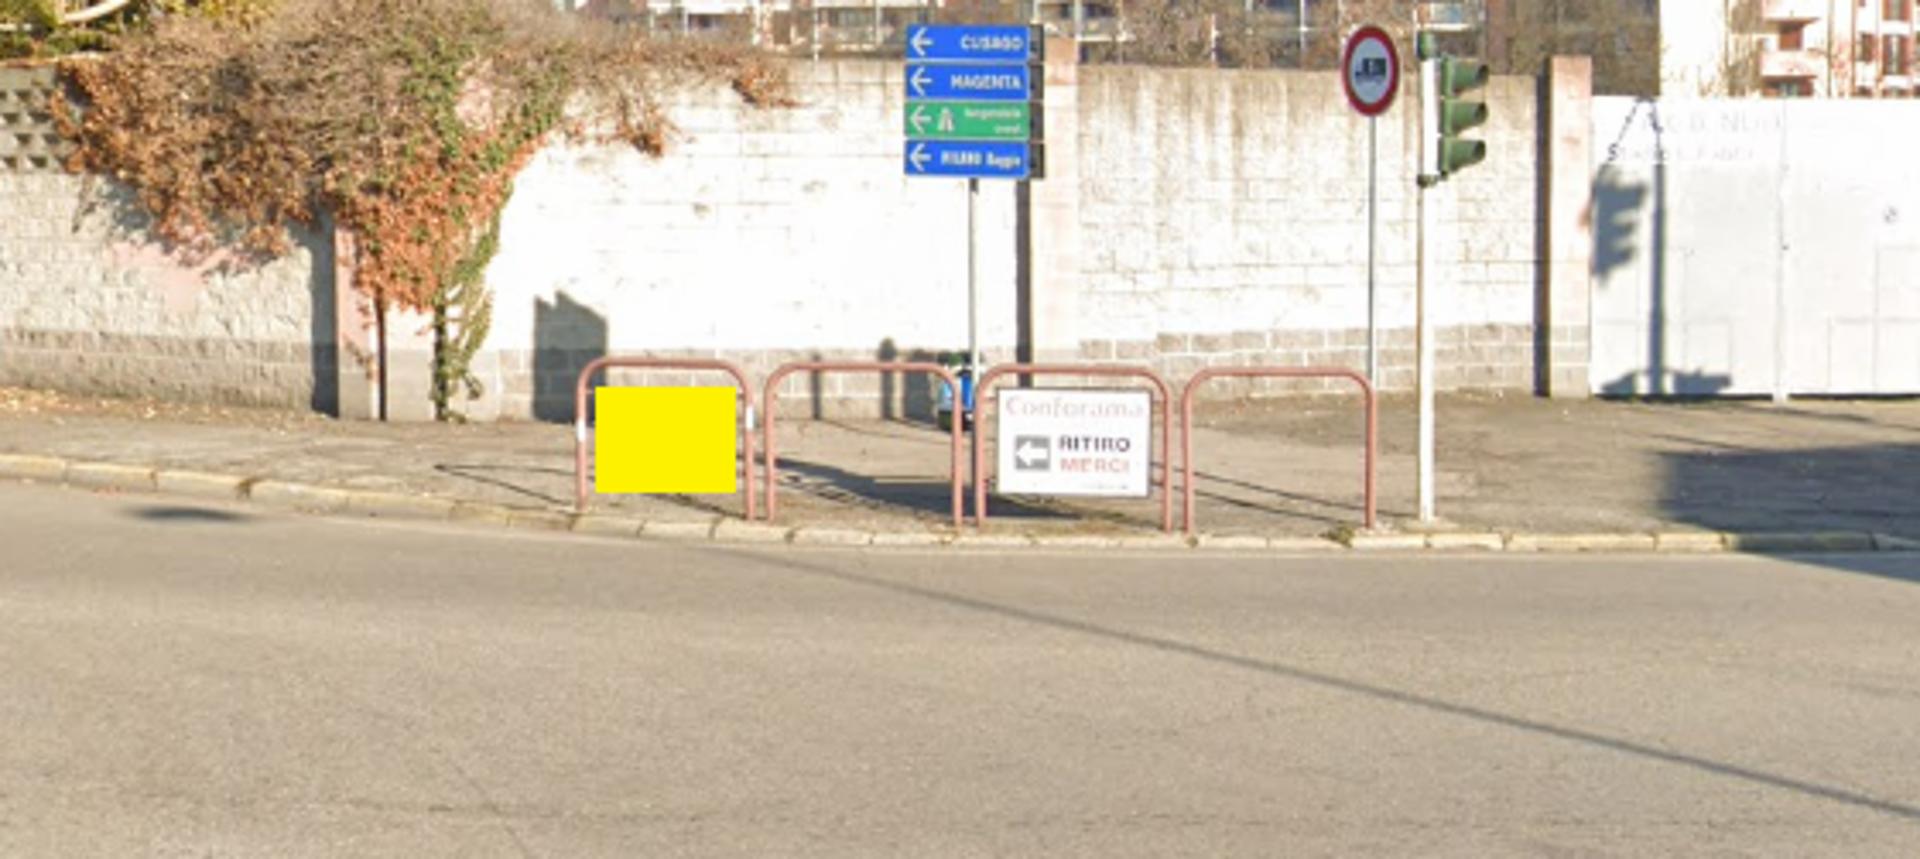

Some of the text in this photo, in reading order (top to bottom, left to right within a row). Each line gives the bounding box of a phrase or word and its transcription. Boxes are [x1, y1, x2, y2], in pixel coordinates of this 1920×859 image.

[961, 36, 1022, 50] CUSAGO
[950, 74, 1021, 90] MAGENTA
[1006, 396, 1144, 418] Conforama
[1058, 435, 1130, 452] RITIRO
[1060, 458, 1130, 474] MERCI
